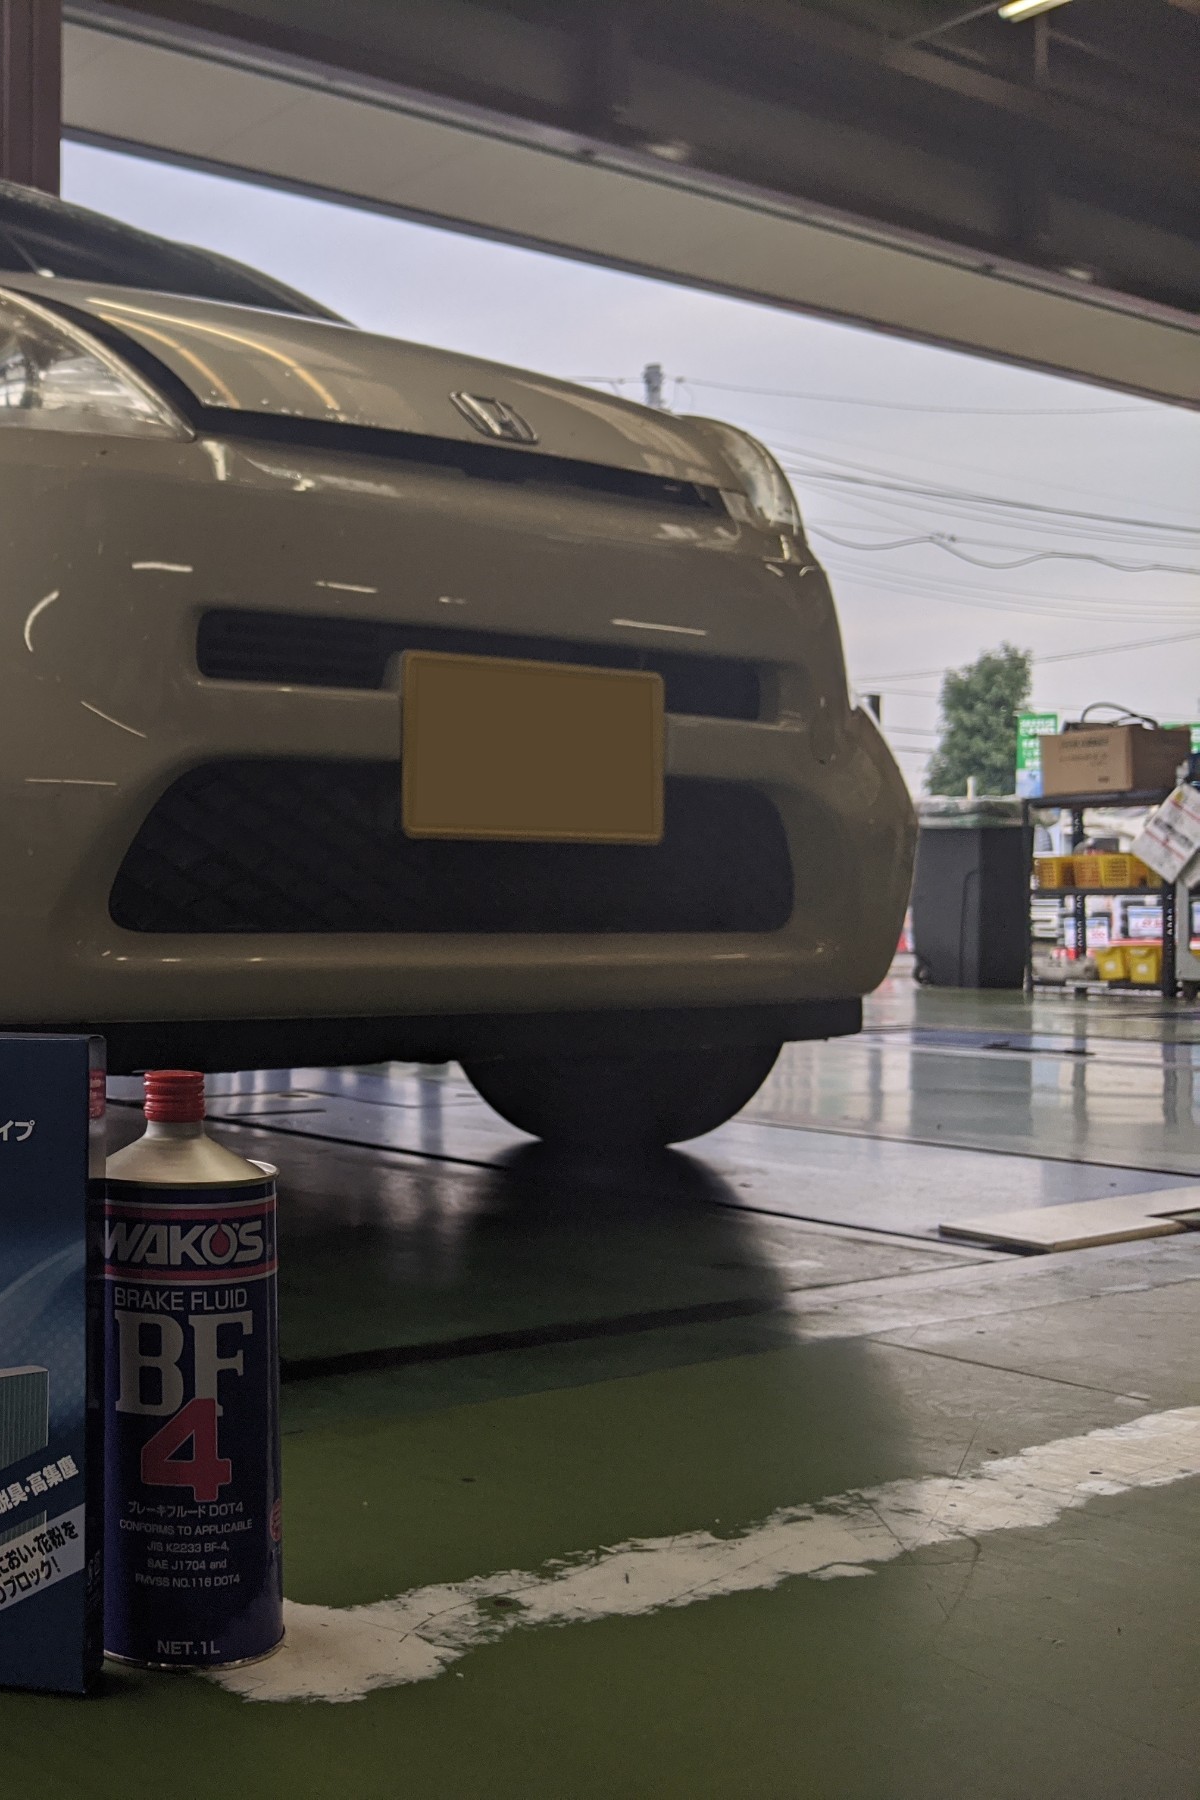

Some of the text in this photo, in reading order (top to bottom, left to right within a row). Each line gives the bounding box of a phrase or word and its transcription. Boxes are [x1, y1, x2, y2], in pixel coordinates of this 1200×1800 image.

[105, 1219, 264, 1266] WAKO'S
[114, 1286, 248, 1311] BRAKE FLUID
[114, 1309, 253, 1417] BF
[141, 1397, 232, 1503] 4
[128, 1501, 244, 1519] ブレーキフルード DOT4
[119, 1518, 253, 1536] CONFORMS TO APPLICABLE
[147, 1541, 163, 1552] JIS
[166, 1542, 200, 1553] K2233
[147, 1558, 227, 1571] SAE J1704 and
[213, 1573, 241, 1586] DOT4
